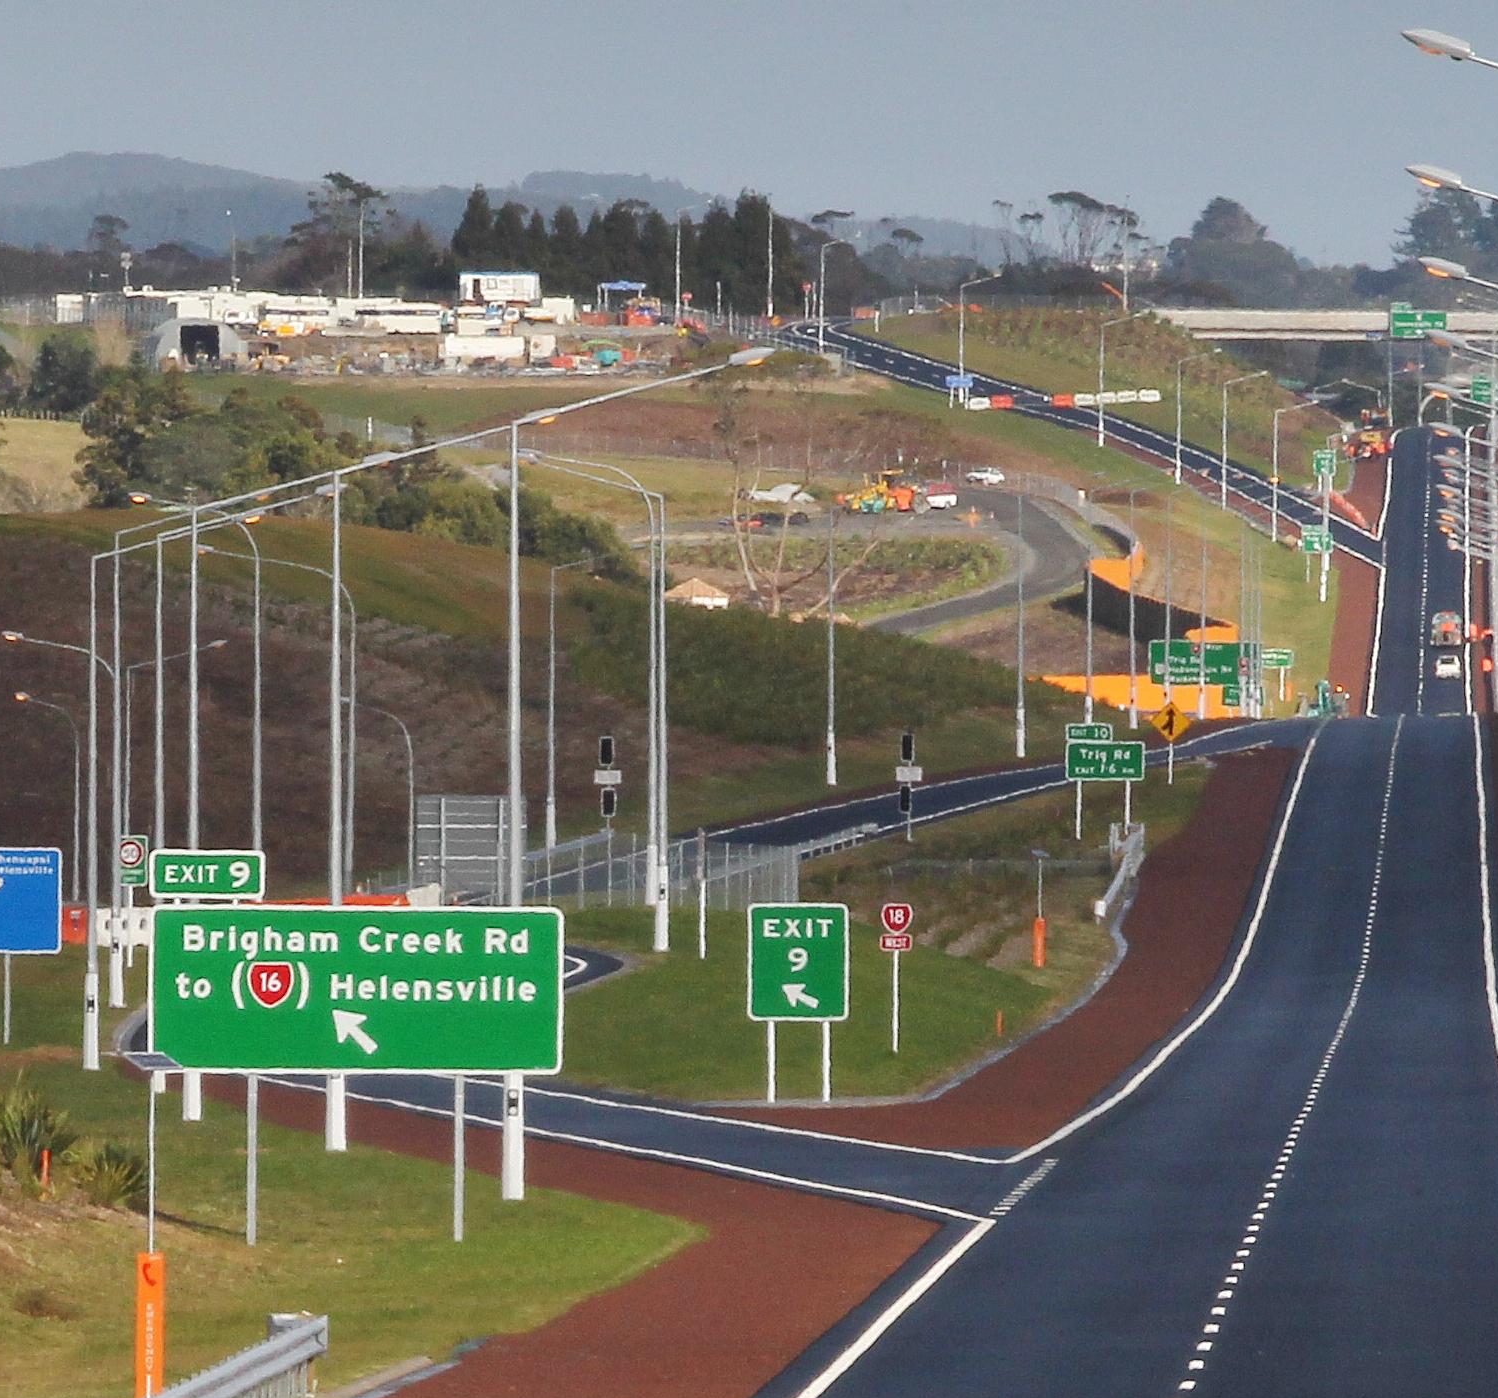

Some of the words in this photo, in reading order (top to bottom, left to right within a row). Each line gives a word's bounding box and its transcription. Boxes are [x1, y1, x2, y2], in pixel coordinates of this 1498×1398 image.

[1094, 727, 1109, 739] 10
[1079, 748, 1107, 764] Trig
[1113, 749, 1131, 760] Rd
[164, 864, 219, 884] EXIT
[229, 860, 251, 889] 9
[762, 918, 834, 939] EXIT
[888, 908, 905, 925] 18
[183, 924, 339, 958] Brigham
[358, 925, 463, 954] Creek
[484, 926, 529, 955] Rd
[884, 937, 907, 948] WEST
[787, 946, 809, 973] 9
[174, 972, 212, 1000] to
[329, 973, 537, 1003] Helensville
[145, 1303, 155, 1372] EMERGENCY
